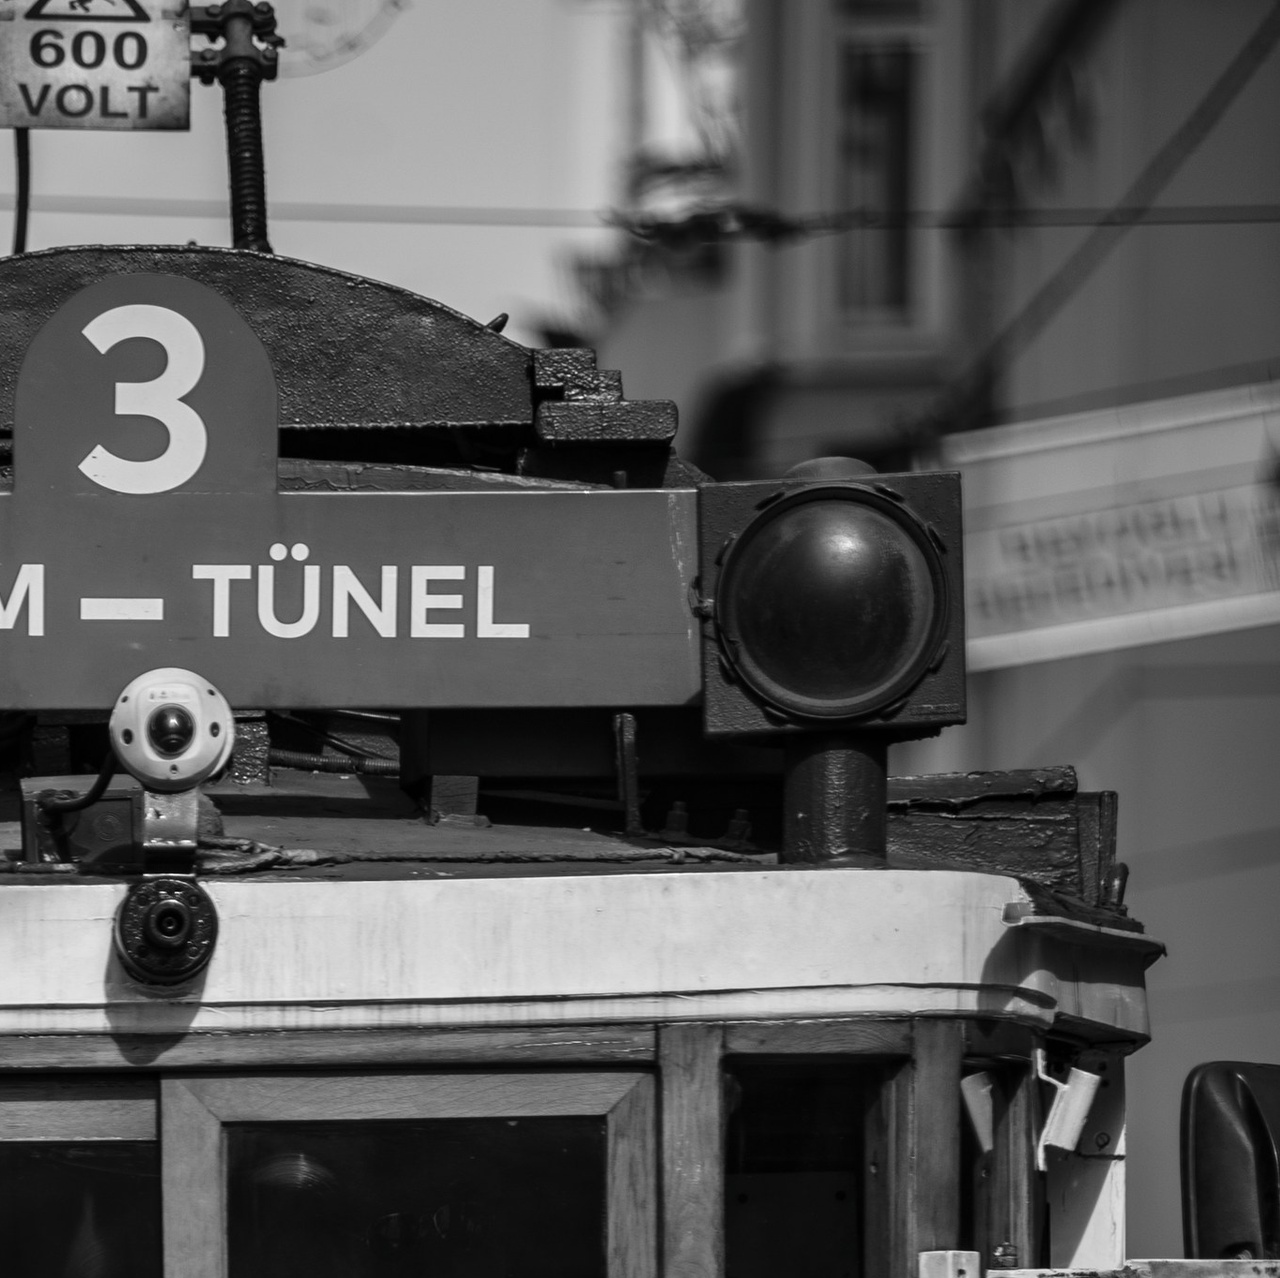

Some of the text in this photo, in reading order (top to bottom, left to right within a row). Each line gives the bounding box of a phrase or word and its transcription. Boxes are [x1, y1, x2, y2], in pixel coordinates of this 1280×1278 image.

[29, 29, 148, 70] 600
[18, 83, 159, 119] VOLT
[77, 304, 207, 495] 3
[192, 543, 530, 638] TÜNEL
